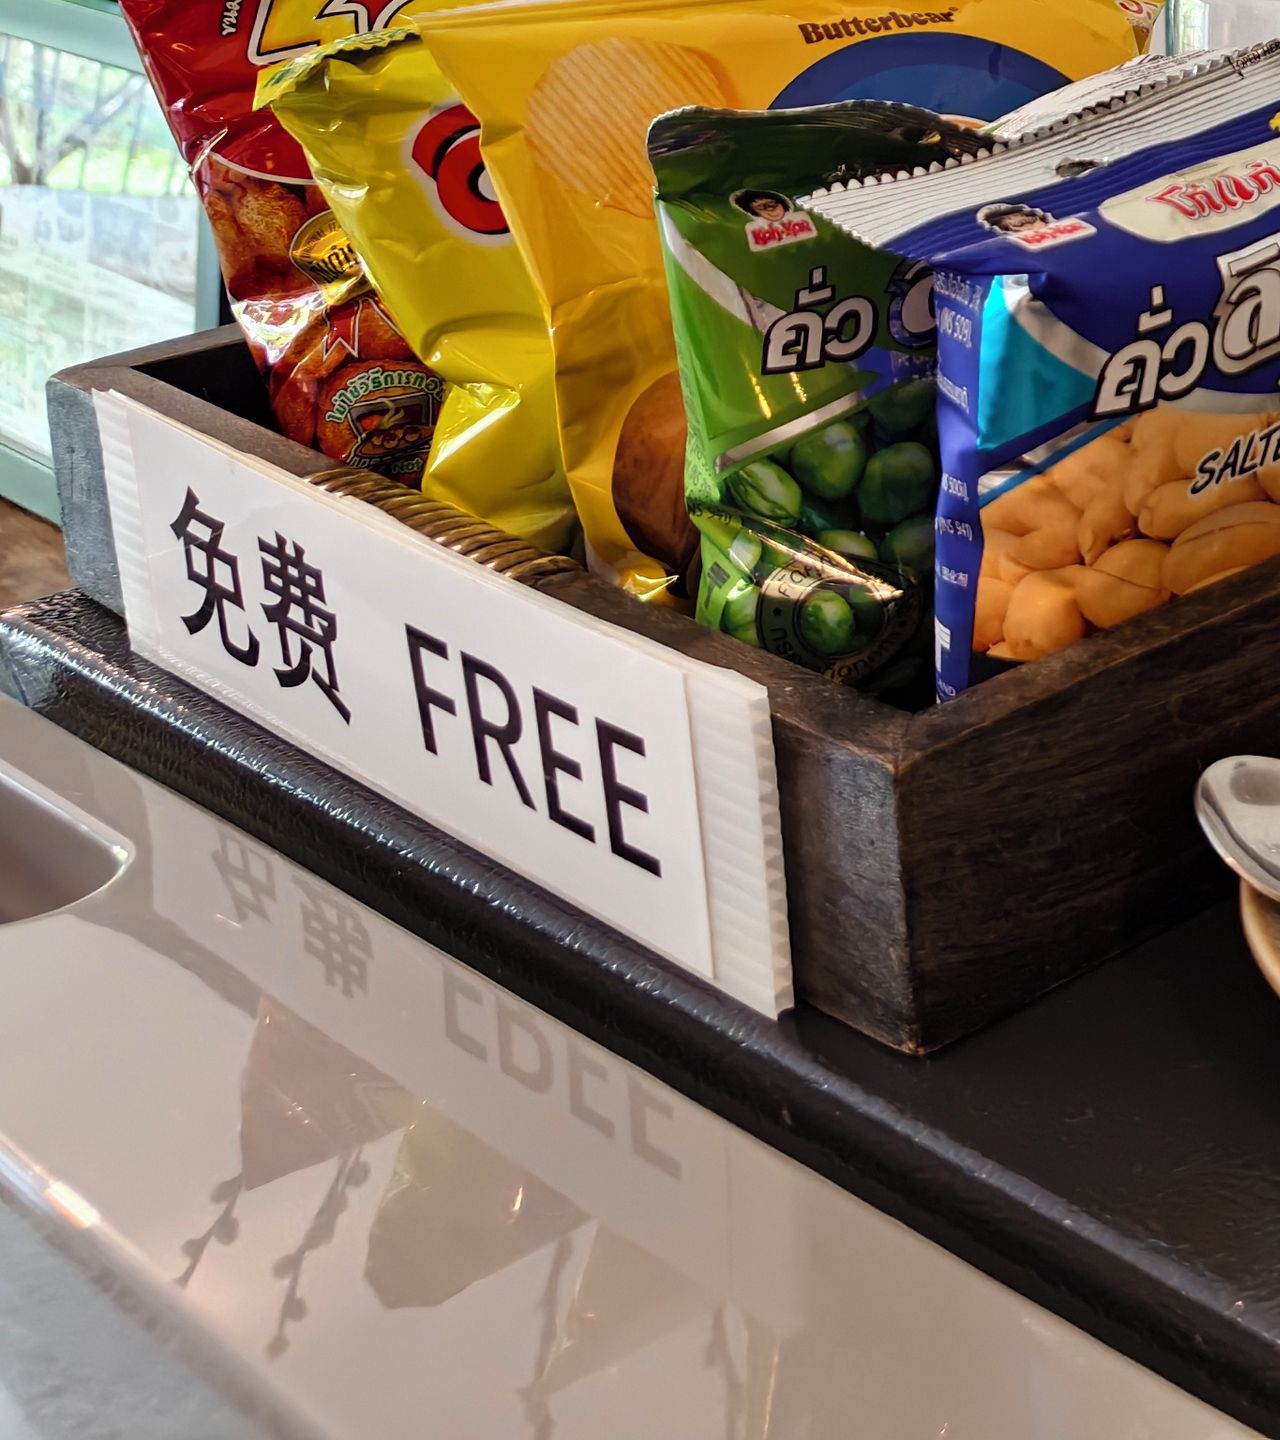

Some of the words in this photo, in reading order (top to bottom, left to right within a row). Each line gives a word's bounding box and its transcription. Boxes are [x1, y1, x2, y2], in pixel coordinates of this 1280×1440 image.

[798, 8, 956, 45] Butterbear
[1236, 51, 1261, 70] OPEN
[169, 486, 351, 725] 免费
[404, 623, 663, 880] FREE
